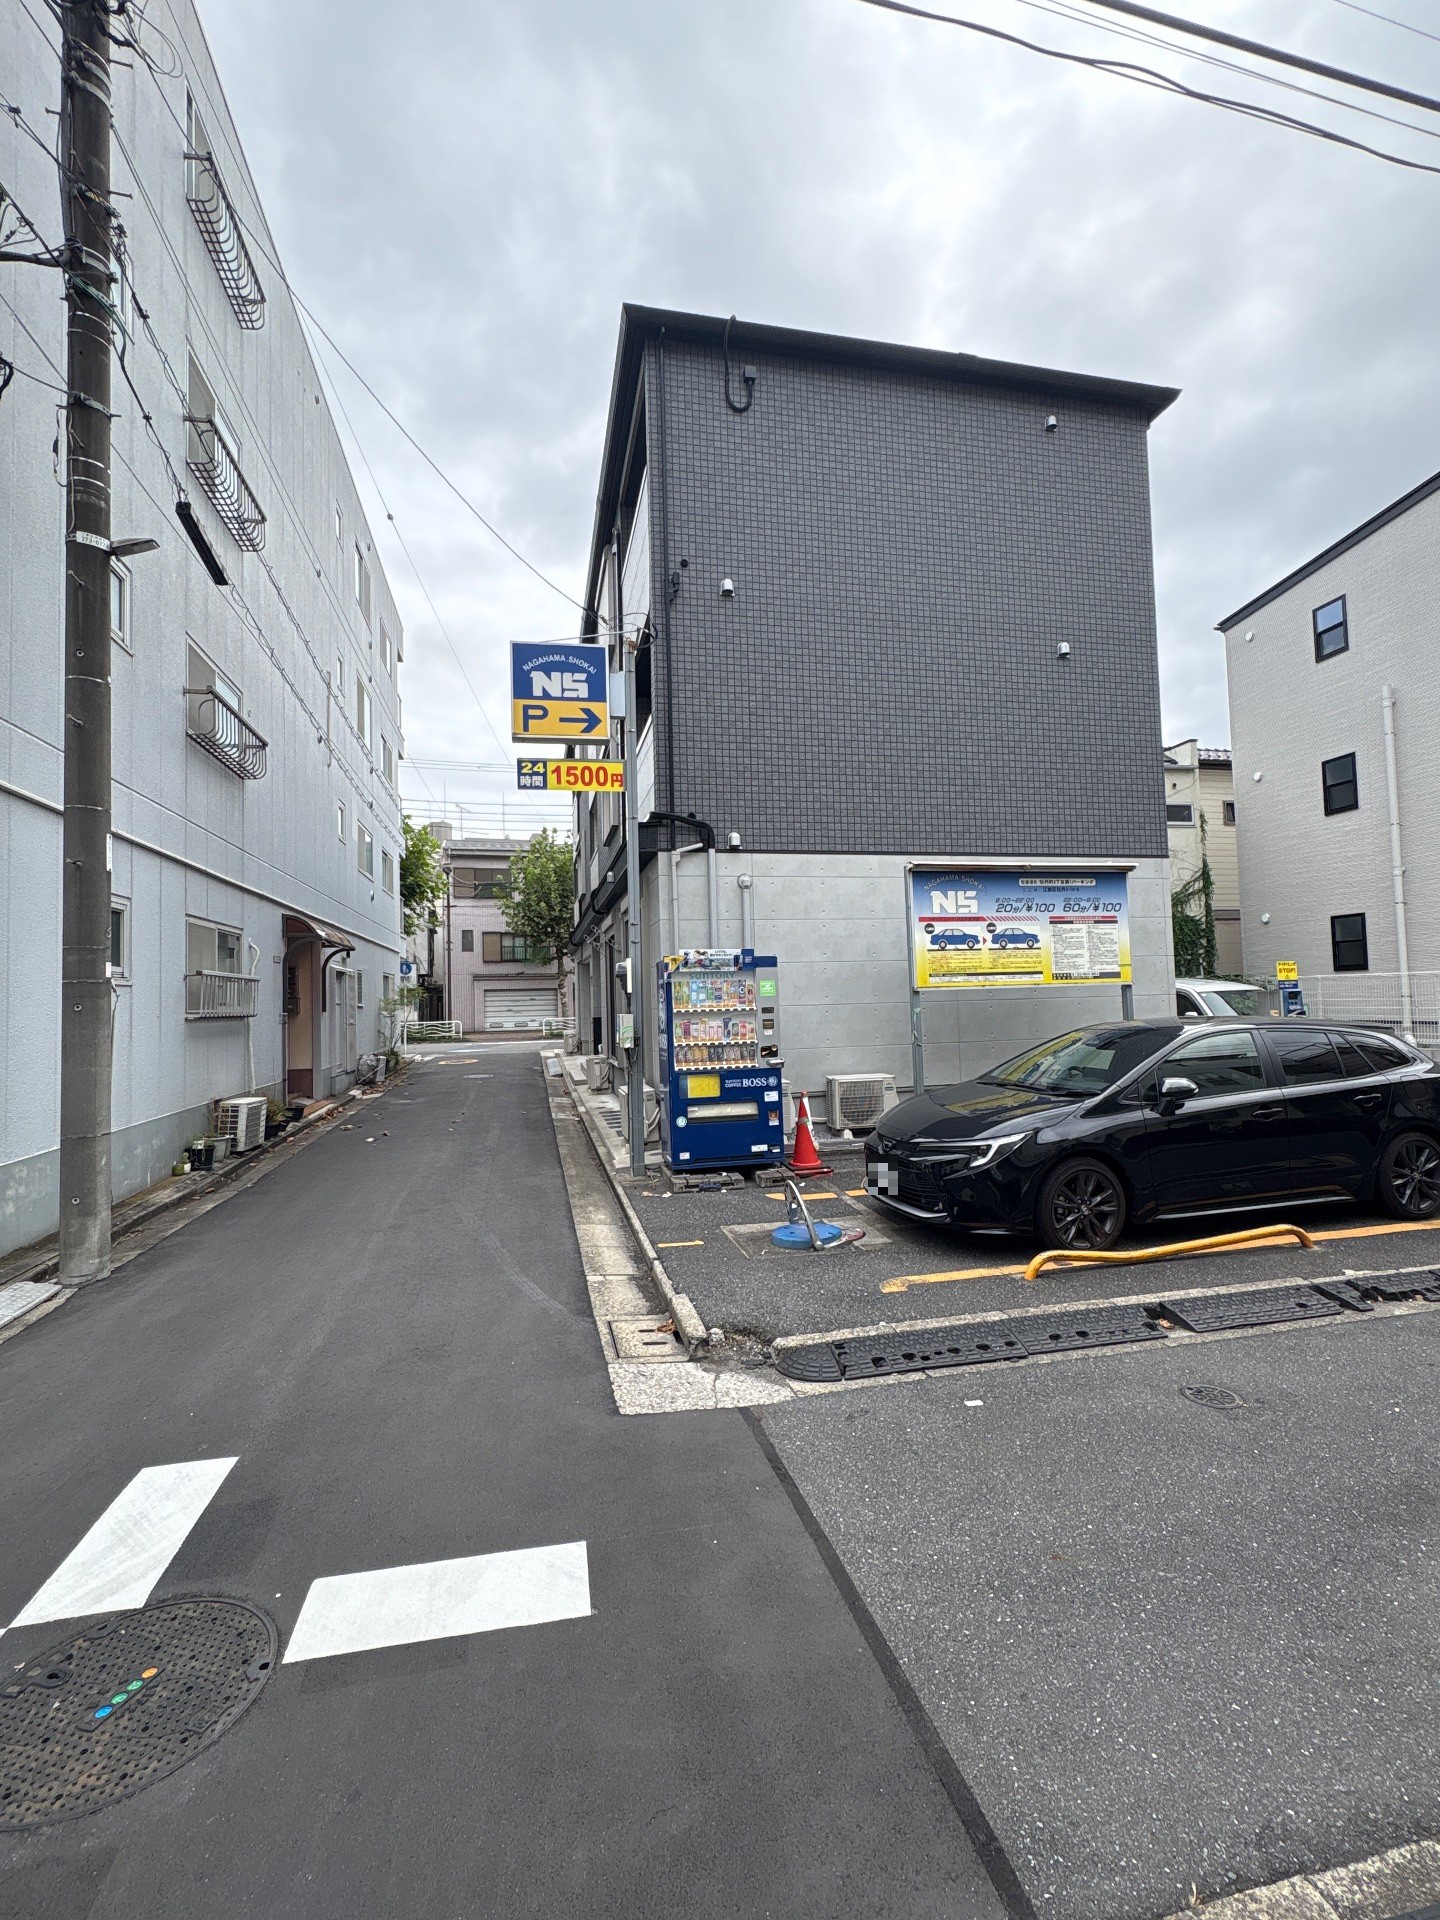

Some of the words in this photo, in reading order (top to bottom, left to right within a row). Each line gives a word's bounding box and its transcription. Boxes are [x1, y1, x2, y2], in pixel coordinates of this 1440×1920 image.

[522, 654, 565, 671] NAGAHAMA
[568, 656, 597, 674] SHOKAI
[530, 670, 589, 698] NS
[522, 704, 549, 732] P
[521, 762, 545, 773] 24
[551, 765, 623, 787] 1500円
[520, 775, 544, 787] 時間
[923, 874, 959, 891] NAGAHAMA
[961, 875, 985, 891] SHOKAI
[930, 890, 979, 914] NS
[742, 1077, 767, 1088] BOSS
